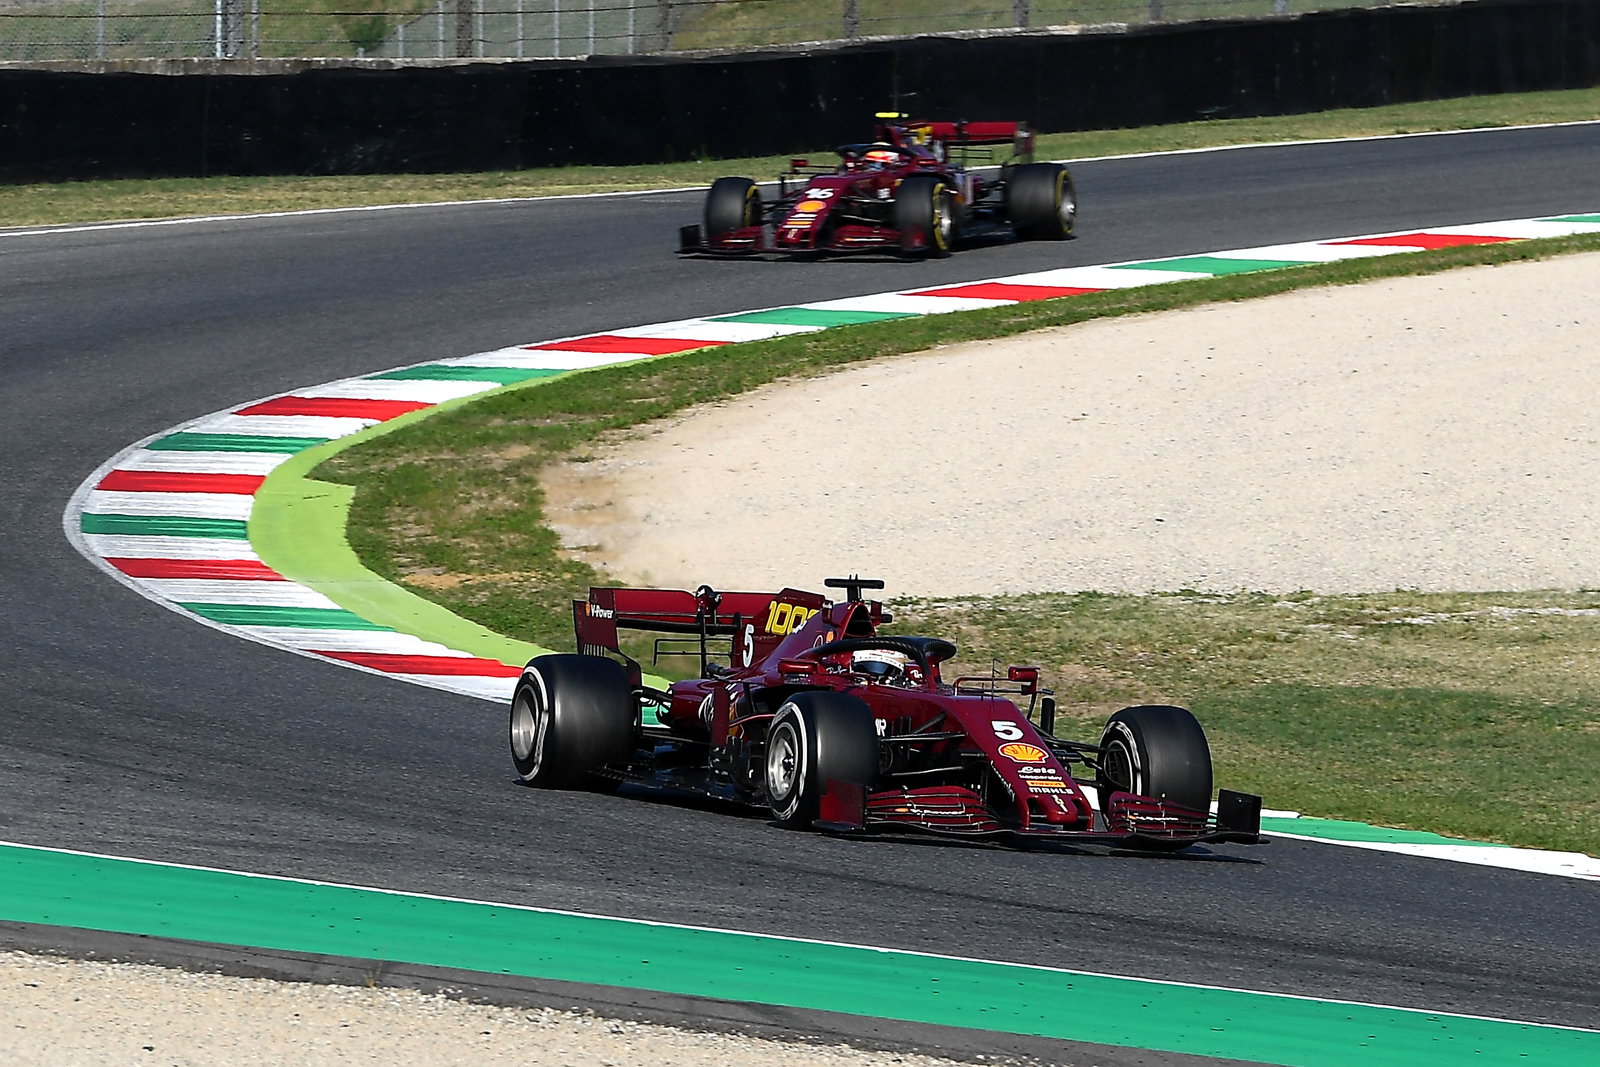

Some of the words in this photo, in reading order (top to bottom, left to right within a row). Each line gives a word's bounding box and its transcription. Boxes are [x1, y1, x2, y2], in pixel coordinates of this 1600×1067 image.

[804, 187, 834, 199] 16
[591, 604, 613, 619] V-Power
[742, 623, 754, 668] 5
[991, 720, 1024, 741] 5
